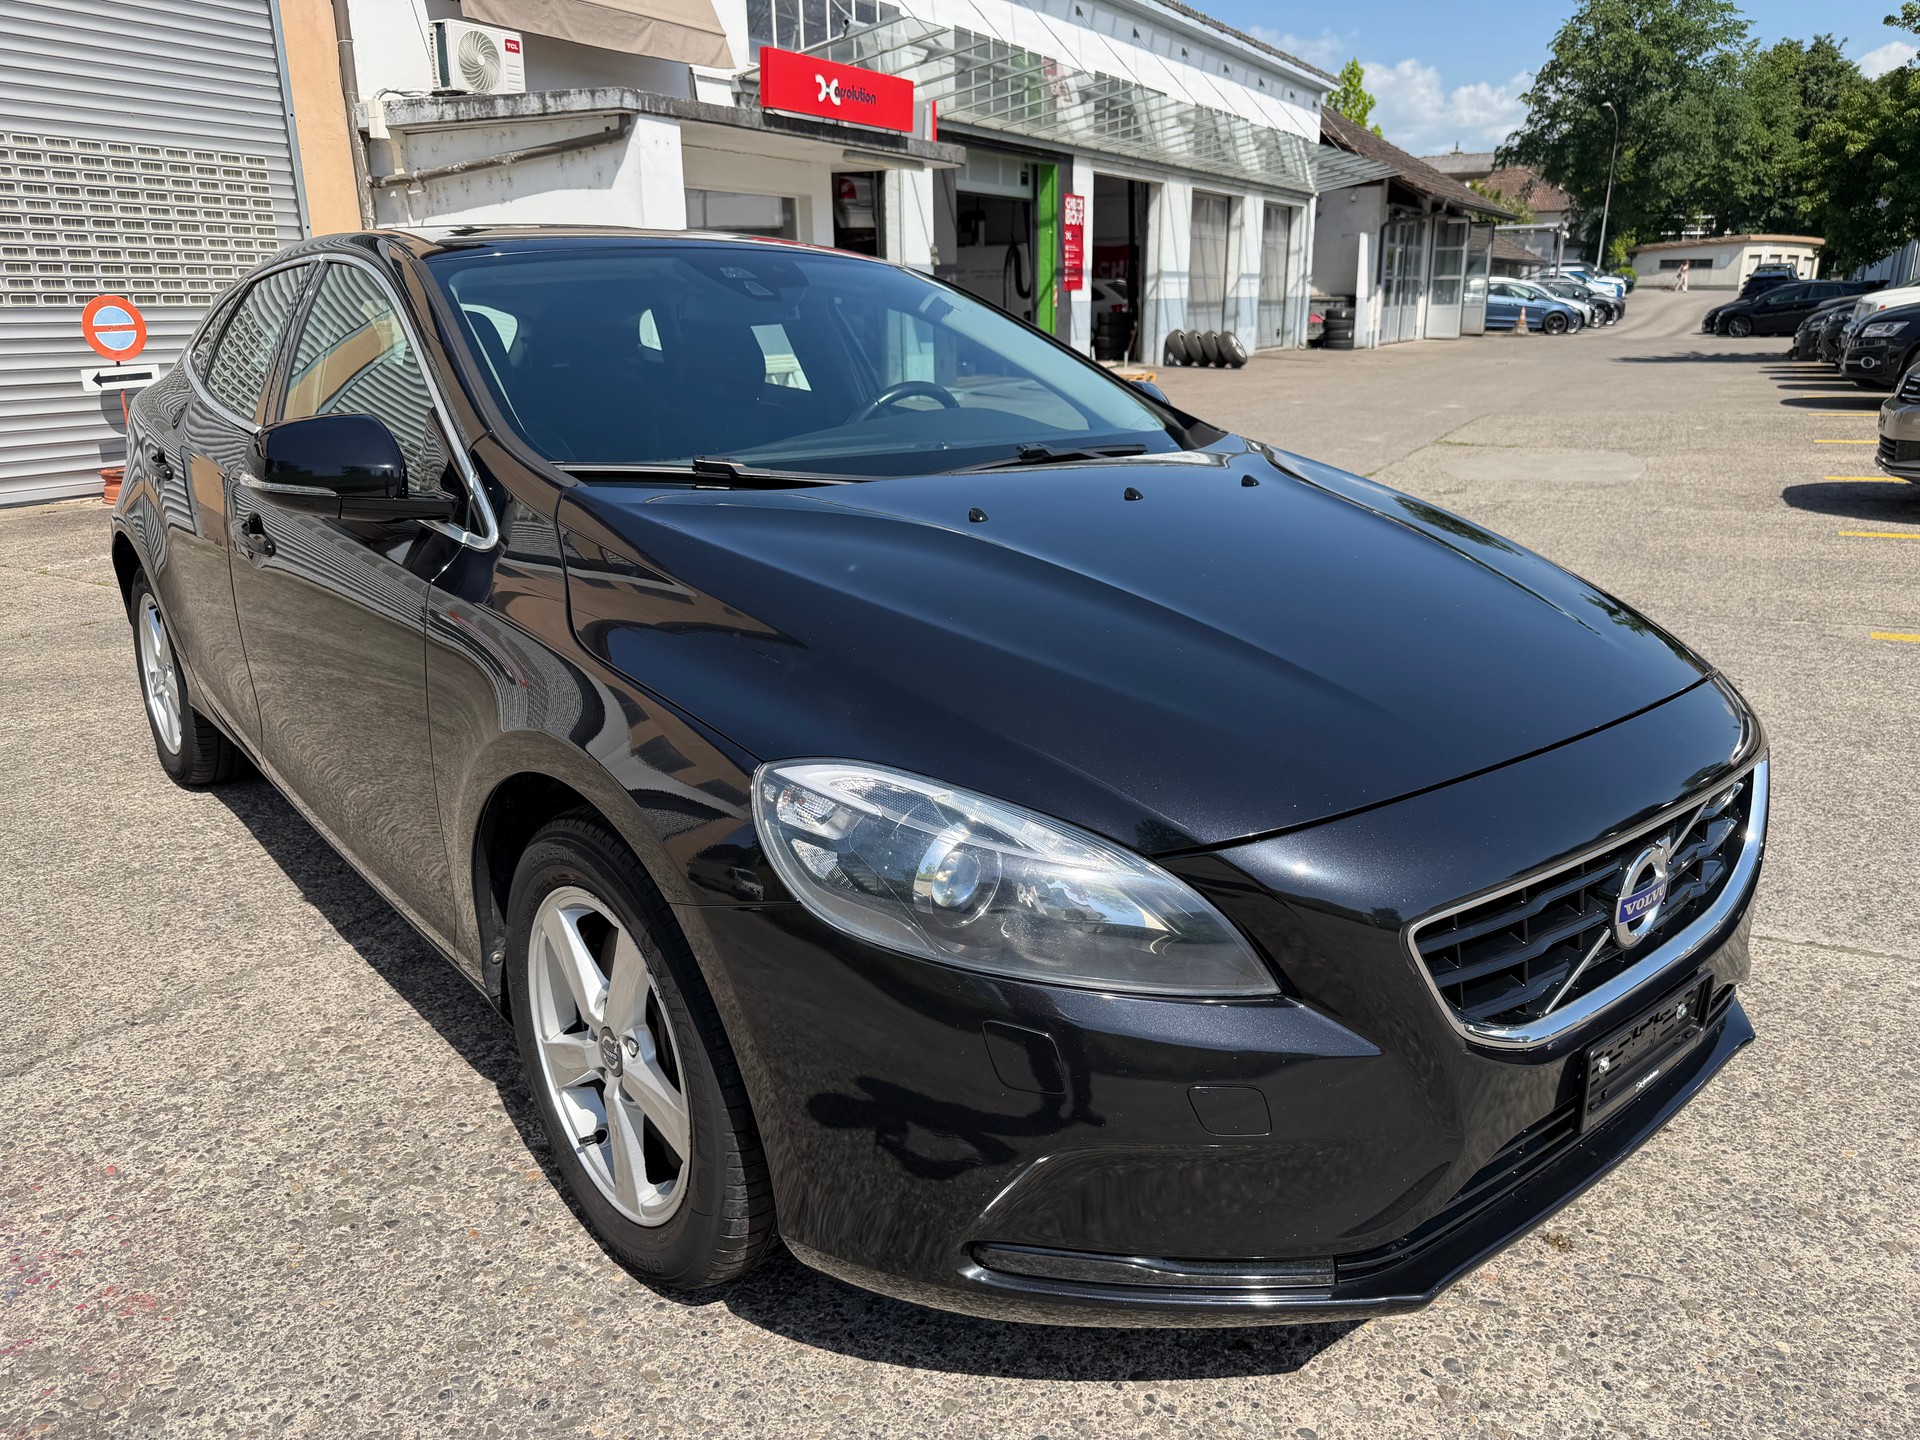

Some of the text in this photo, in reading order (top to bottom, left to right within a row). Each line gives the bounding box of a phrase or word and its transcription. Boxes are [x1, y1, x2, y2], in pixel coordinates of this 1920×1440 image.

[506, 42, 519, 51] TCL
[1064, 209, 1084, 226] BOX
[1623, 882, 1665, 915] VOLVO
